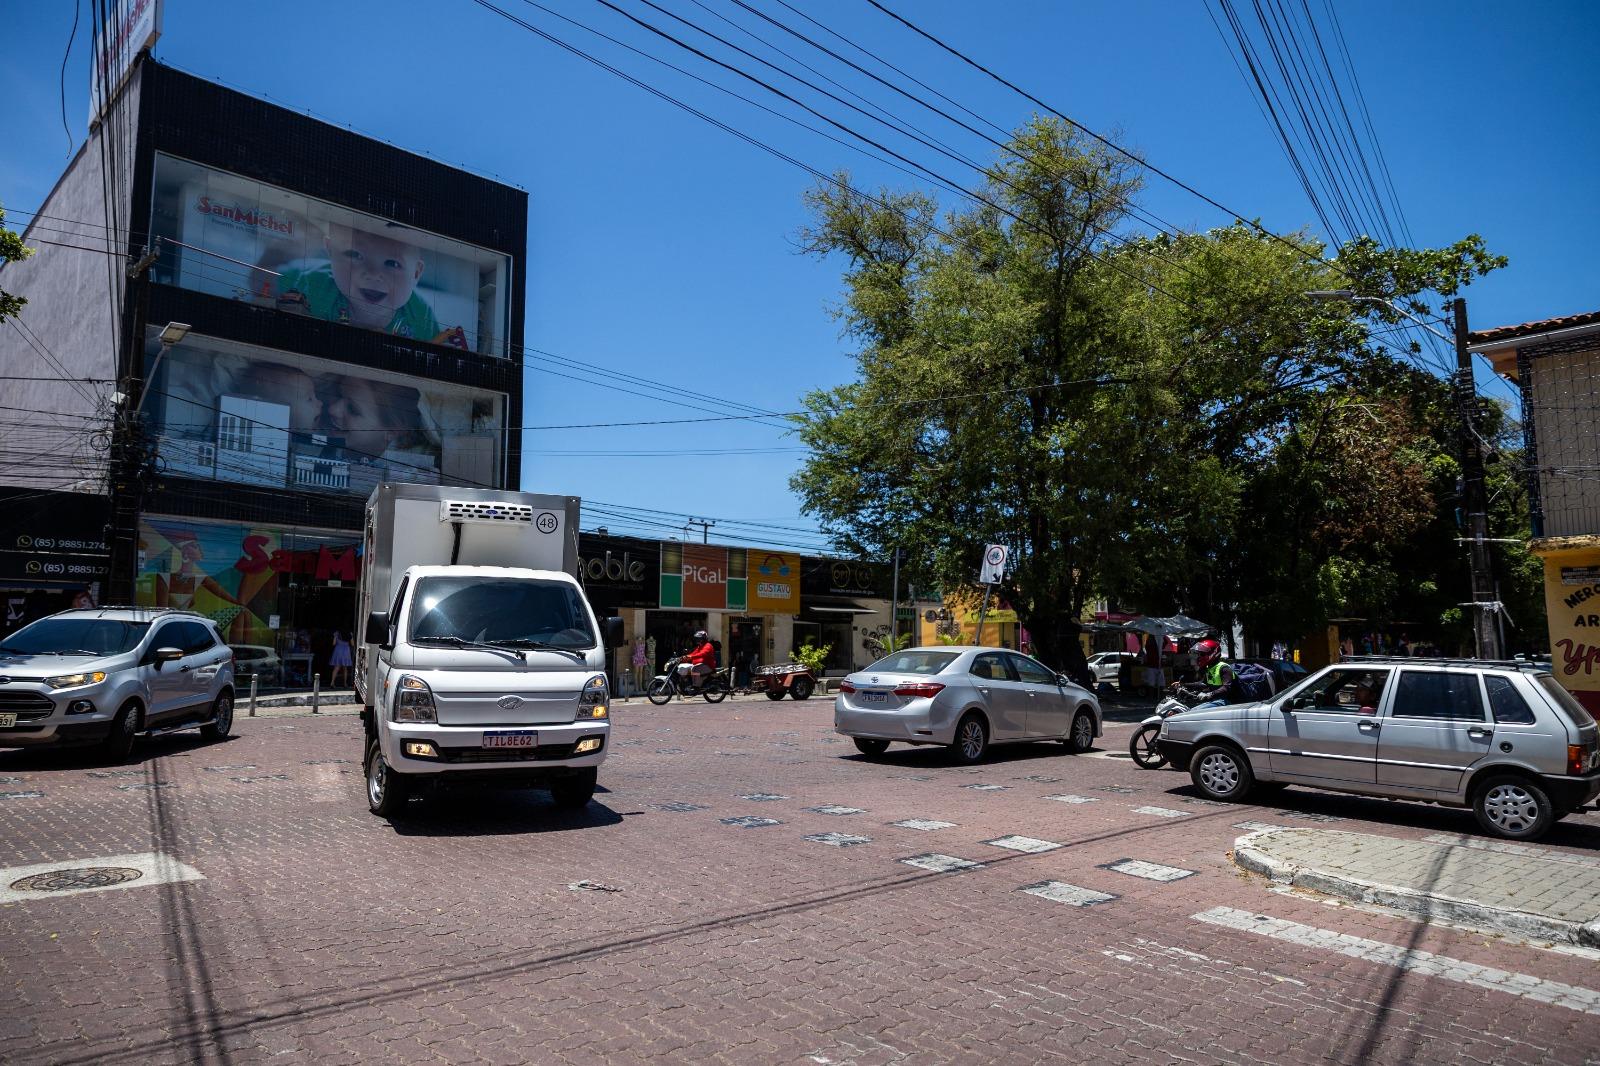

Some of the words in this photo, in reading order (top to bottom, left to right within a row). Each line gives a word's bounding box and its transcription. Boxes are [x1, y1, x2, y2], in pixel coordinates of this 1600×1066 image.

[197, 196, 294, 235] SanMichel
[540, 517, 555, 529] 48
[35, 538, 55, 548] (85)
[58, 540, 110, 551] 98851.274
[43, 563, 65, 574] (85)
[758, 583, 791, 594] GUSTAVO
[487, 736, 531, 746] TIL8E62
